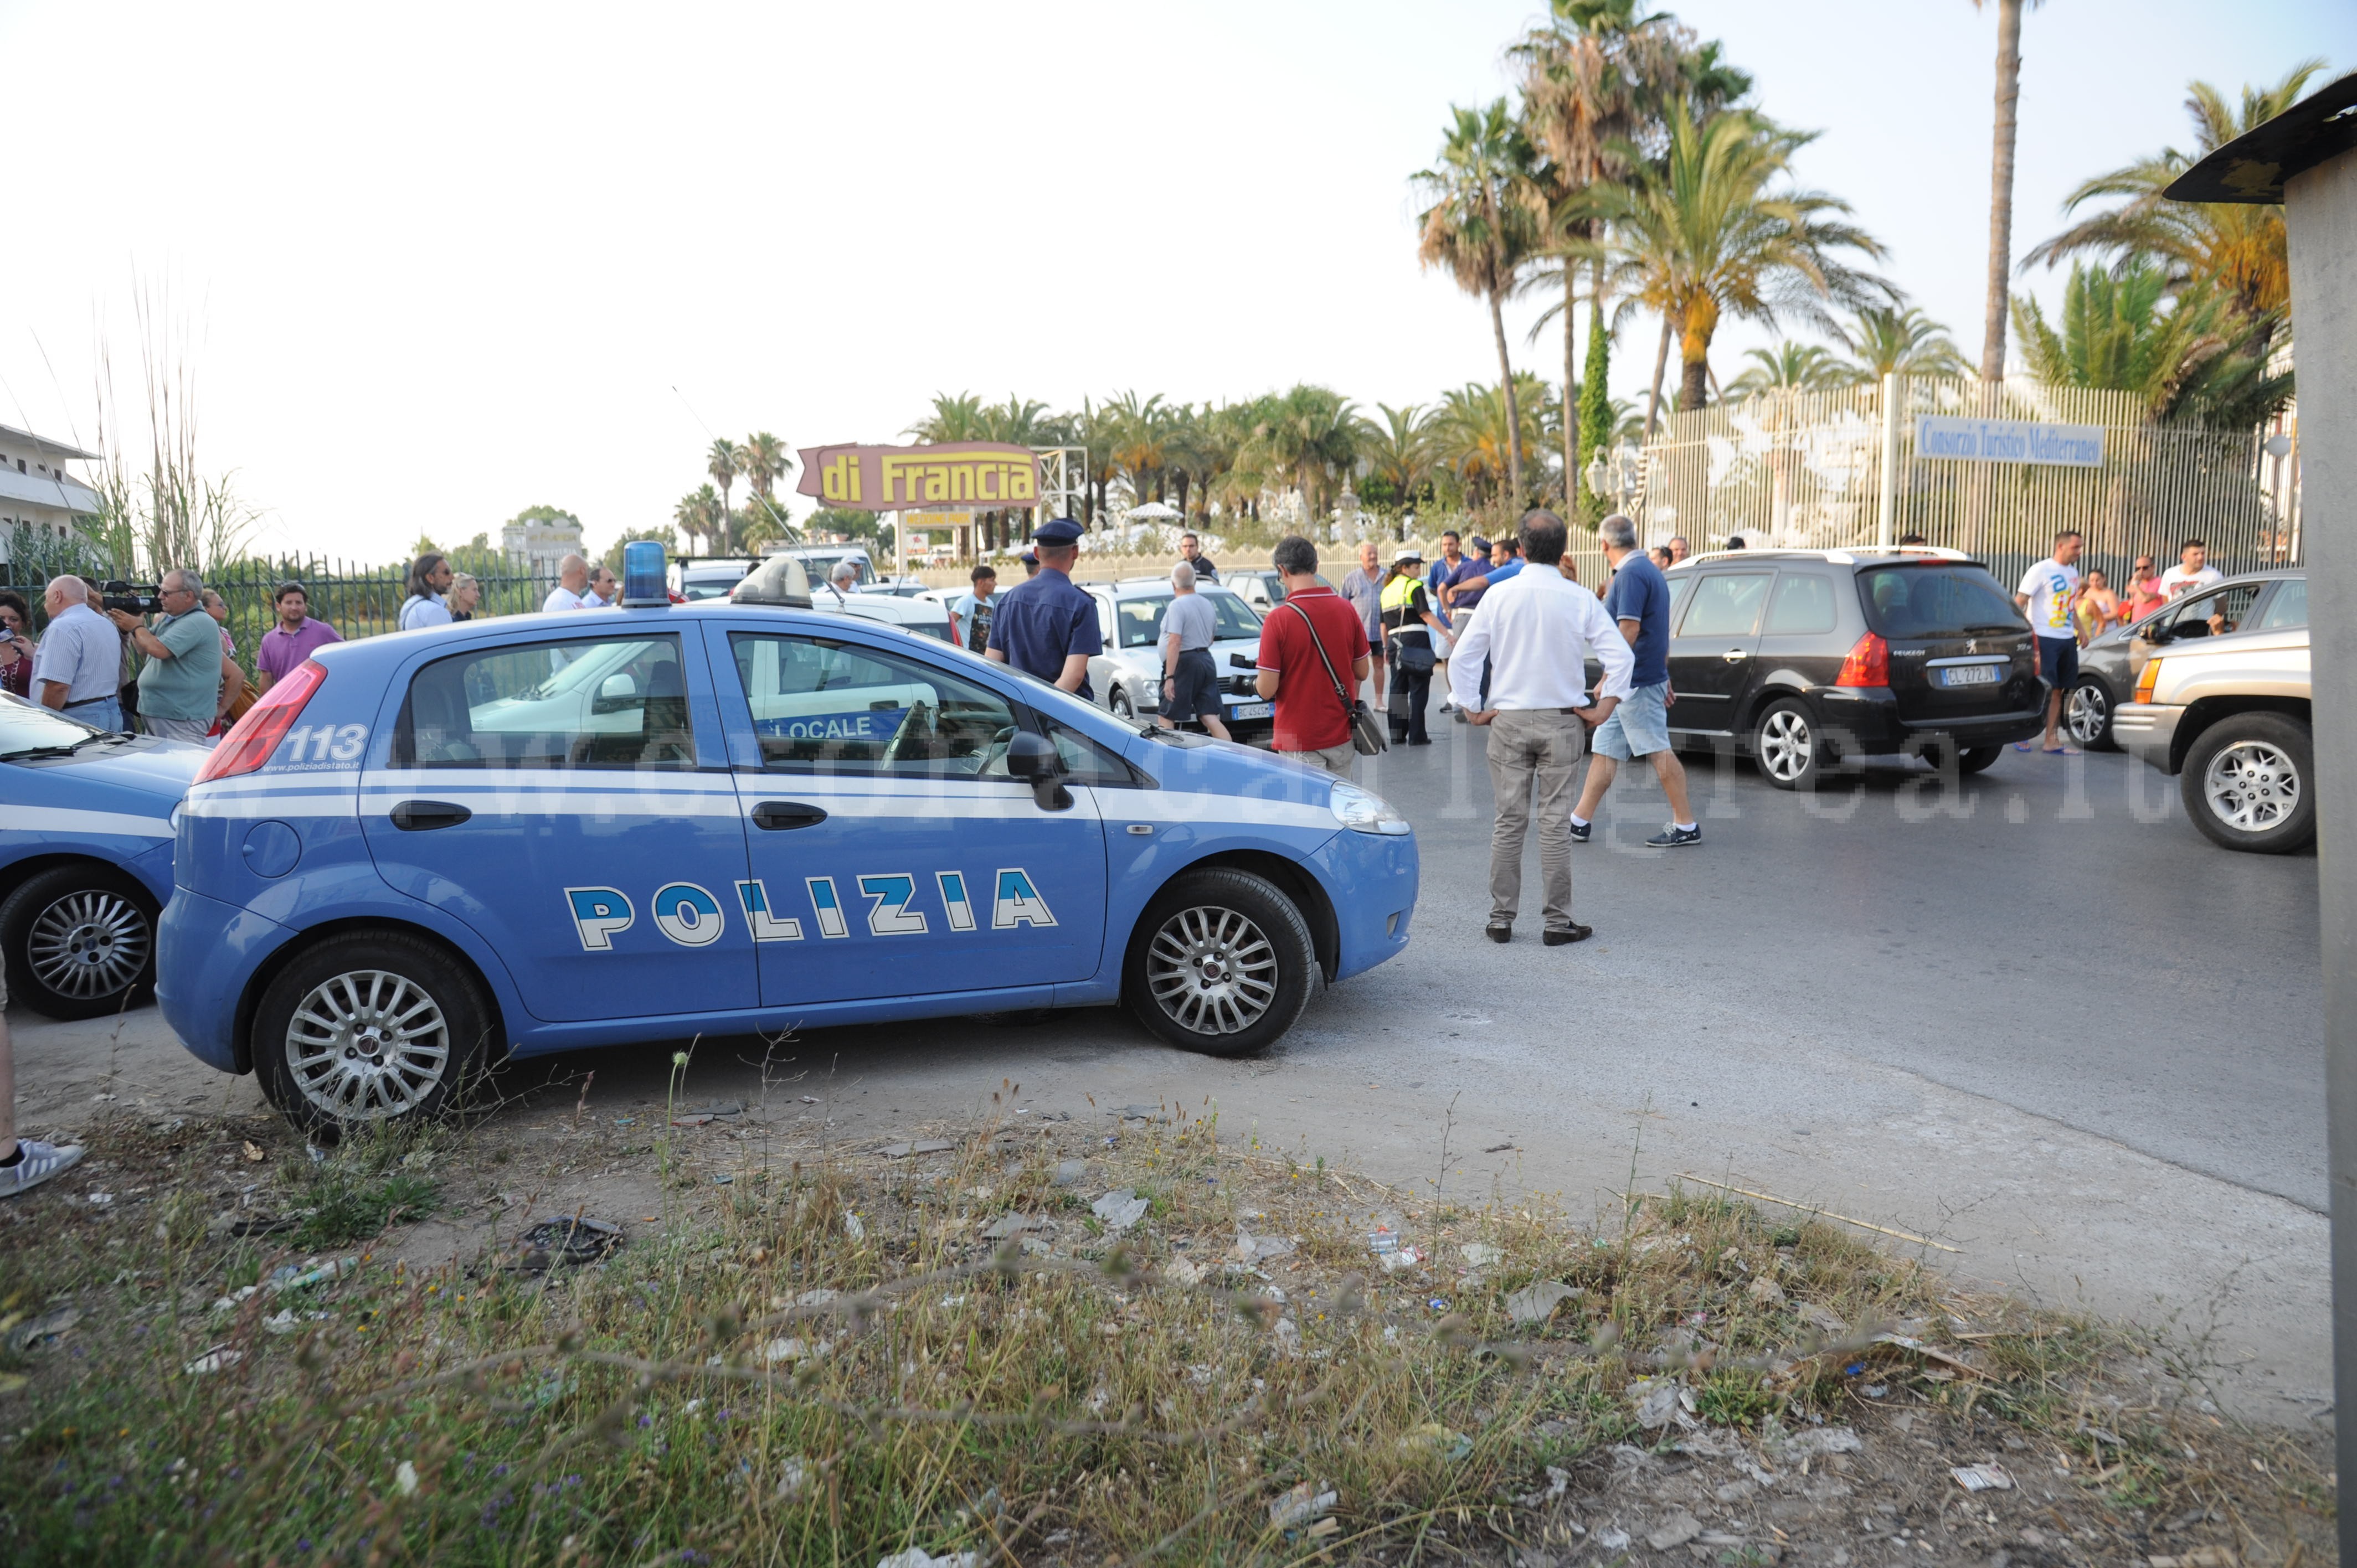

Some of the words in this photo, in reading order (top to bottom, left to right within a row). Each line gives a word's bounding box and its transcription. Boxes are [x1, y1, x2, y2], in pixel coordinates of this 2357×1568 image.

[1922, 420, 1977, 457] Consorzio
[1980, 424, 2025, 459] Turistico
[2029, 427, 2098, 462] Mediterraneo
[822, 455, 861, 502] di
[882, 451, 1035, 502] Francia
[907, 513, 946, 525] WEDDING
[948, 512, 971, 524] PARK
[1893, 649, 1926, 657] PEUGEOT
[1949, 669, 1962, 683] CL
[1964, 666, 1993, 682] 272JV
[1239, 708, 1247, 717] BC
[775, 716, 872, 739] LOCALE
[287, 723, 368, 762] 113
[263, 761, 360, 772] www.poliziadistato.it
[563, 868, 1059, 951] POLIZIA
